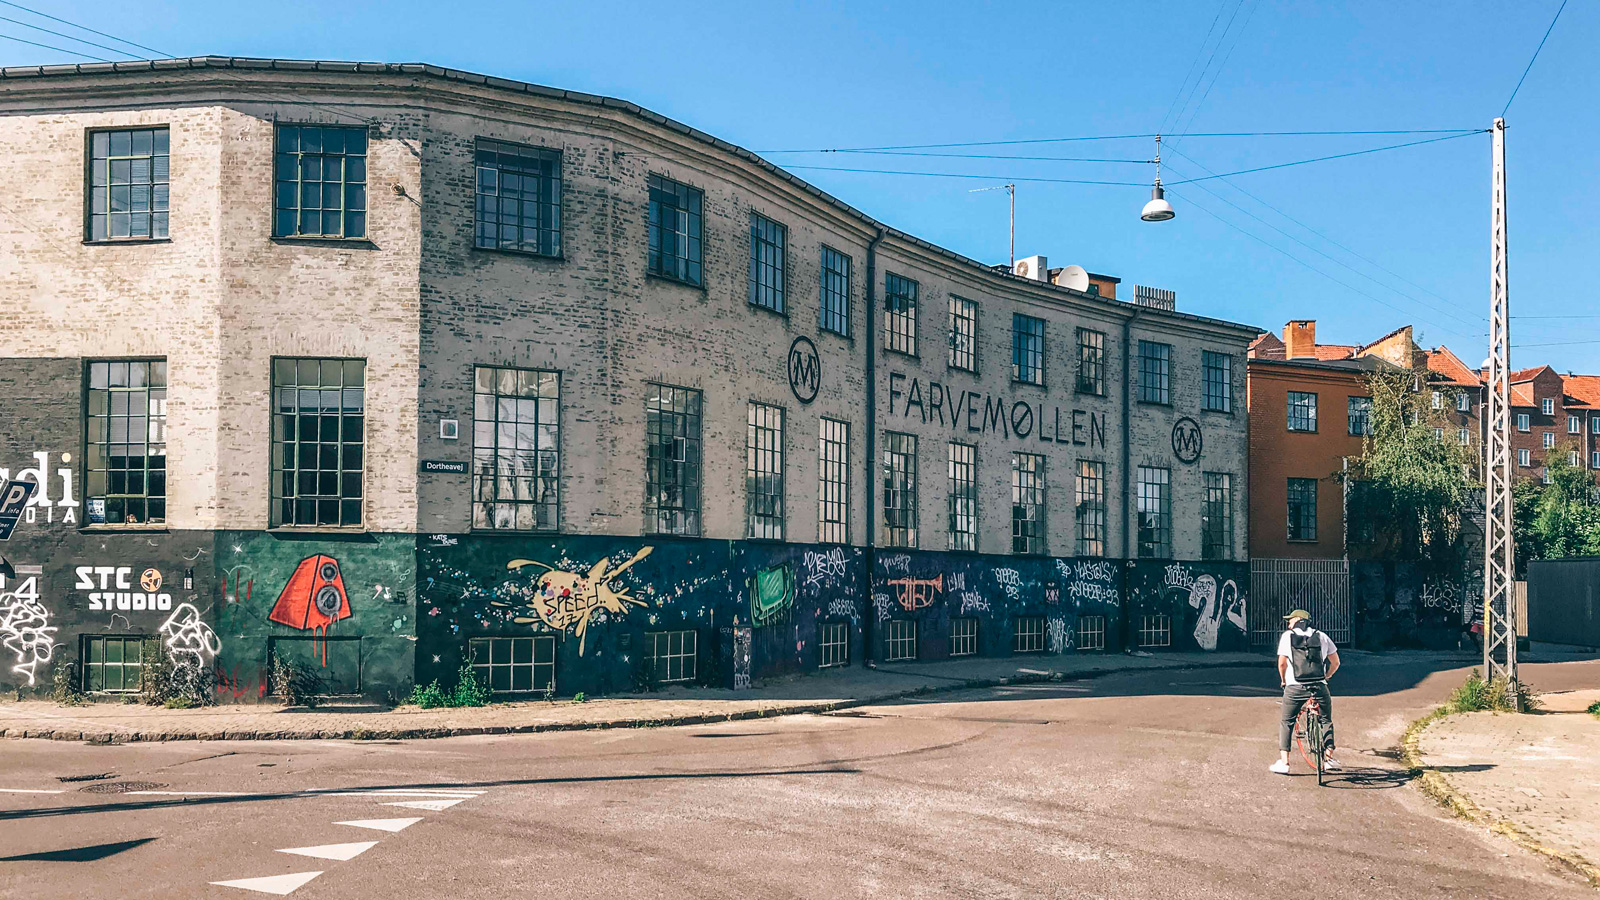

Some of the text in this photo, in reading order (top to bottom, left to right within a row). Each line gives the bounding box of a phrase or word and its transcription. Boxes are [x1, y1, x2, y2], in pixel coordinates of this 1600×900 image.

[890, 372, 1105, 449] FARVEMØLLEN
[426, 462, 464, 472] Dortheavej
[0, 485, 26, 513] P
[75, 566, 132, 590] STC
[88, 592, 172, 611] STUDIO
